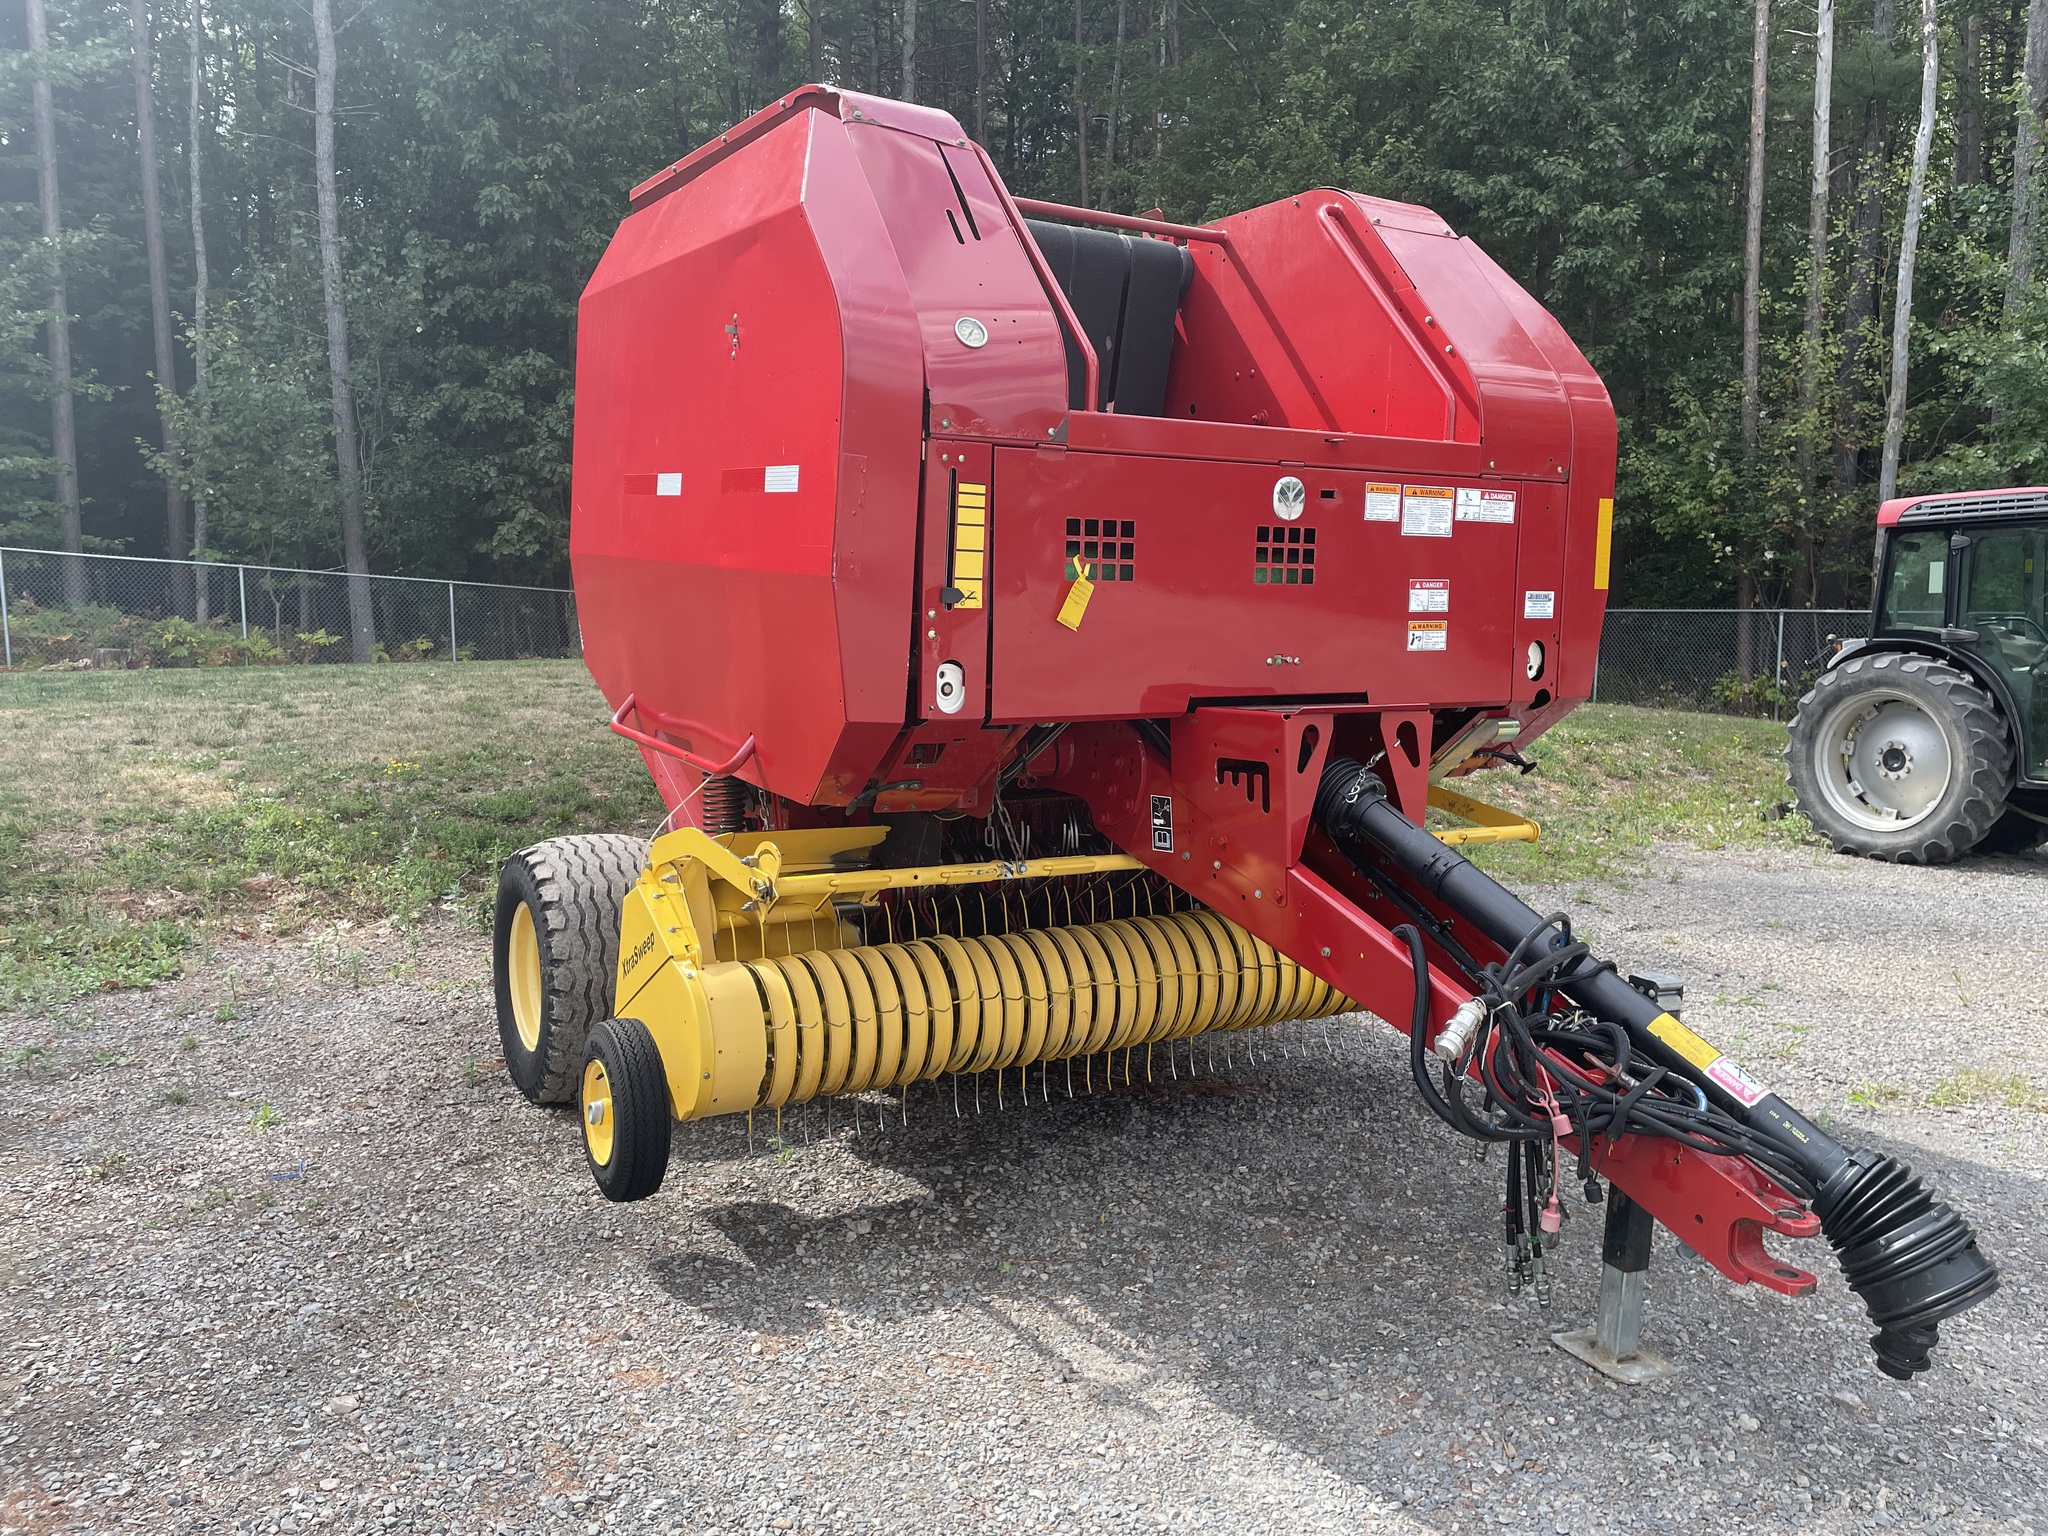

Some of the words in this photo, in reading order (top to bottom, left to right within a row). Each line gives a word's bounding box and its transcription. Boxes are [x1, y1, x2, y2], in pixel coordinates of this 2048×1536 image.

[1420, 489, 1446, 497] WARNING
[1490, 493, 1513, 501] DANGER
[621, 931, 655, 980] XtraSweep
